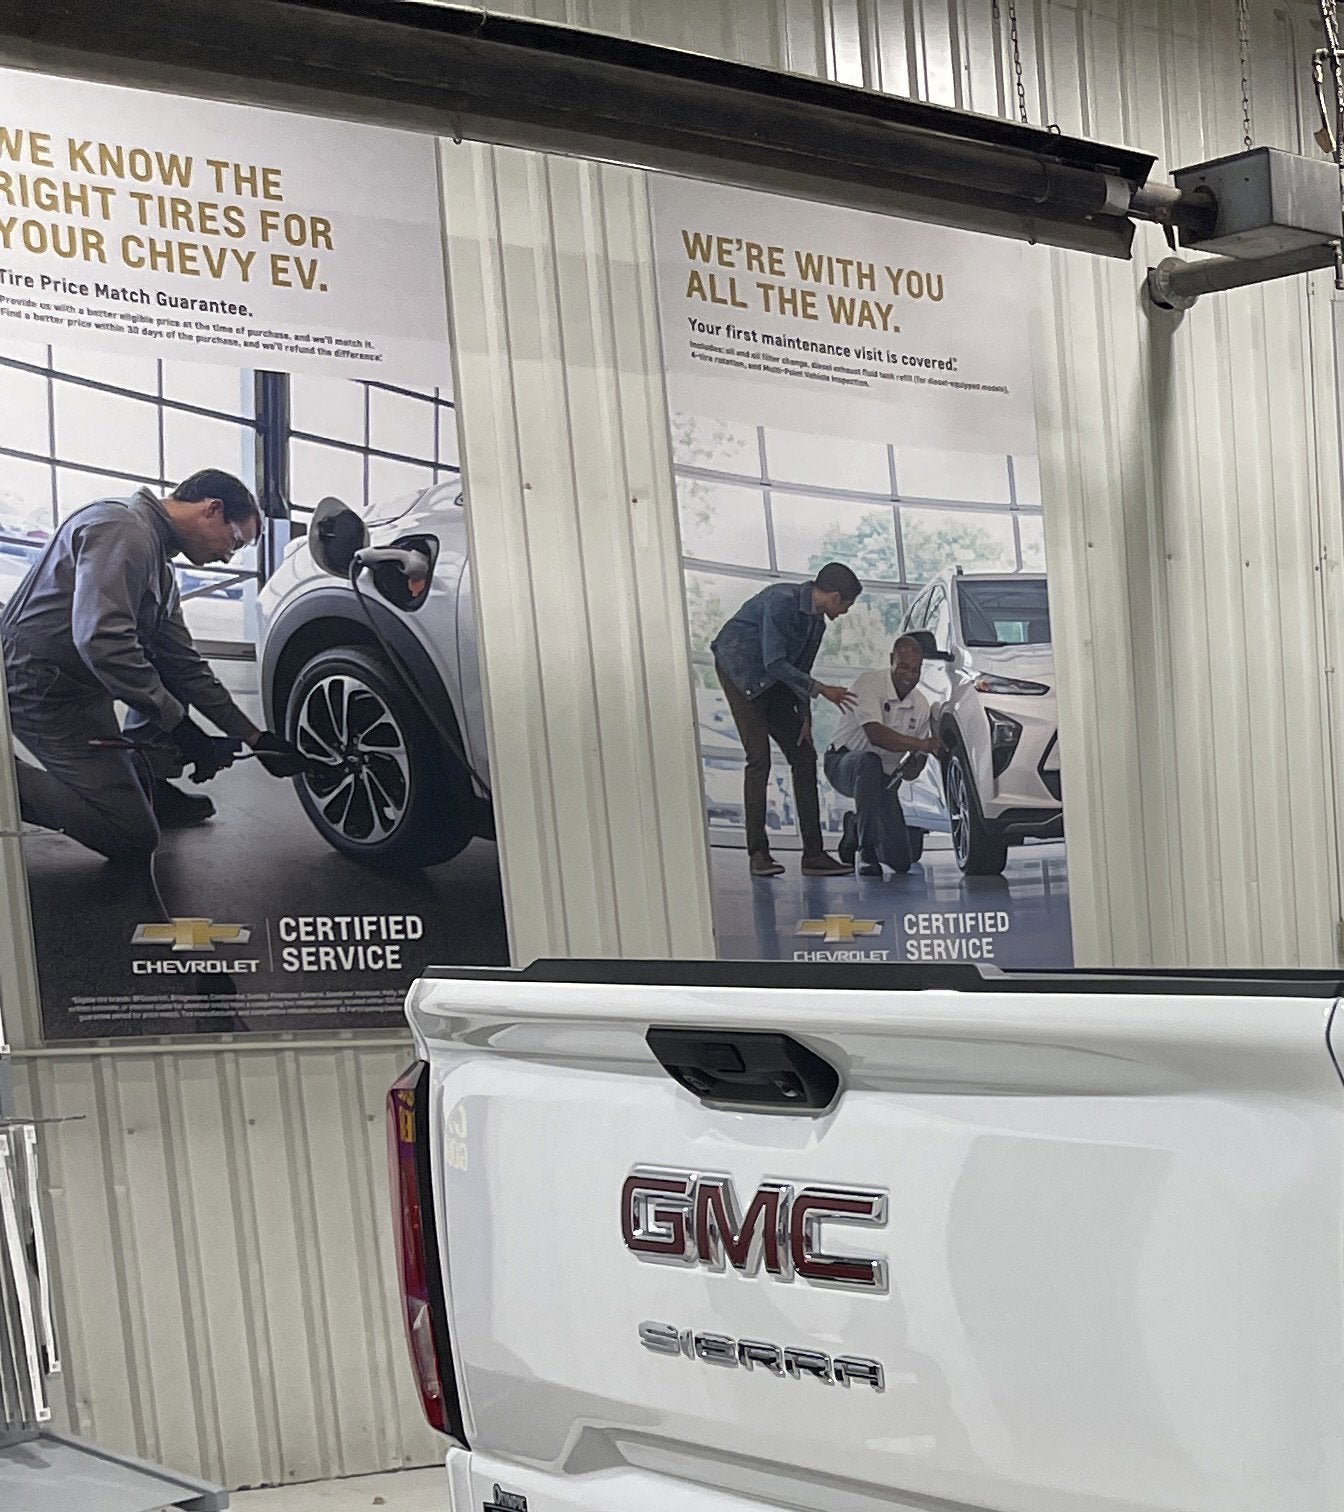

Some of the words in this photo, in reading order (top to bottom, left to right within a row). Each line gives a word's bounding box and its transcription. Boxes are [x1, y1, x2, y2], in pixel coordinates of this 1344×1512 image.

[0, 126, 54, 168] WE
[68, 138, 193, 188] KNOW
[206, 158, 284, 201] THE
[0, 170, 117, 221] RIGHT
[129, 190, 247, 240] TIRES
[260, 209, 334, 251] FOR
[0, 216, 107, 264] YOUR
[121, 234, 256, 283] CHEVY
[270, 253, 328, 292] EV.
[681, 229, 786, 278] WE'RE
[795, 249, 877, 292] WITH
[884, 265, 944, 302] YOU
[0, 269, 34, 288] Tire
[40, 275, 89, 296] Price
[95, 283, 151, 305] Match
[156, 291, 253, 317] Guarantee.
[686, 269, 748, 309] ALL
[756, 282, 819, 321] THE
[827, 294, 901, 334] WAY.
[688, 317, 721, 336] Your
[726, 324, 758, 343] first
[762, 333, 850, 357] maintenance
[854, 346, 884, 362] visit
[886, 350, 898, 364] is
[279, 915, 423, 942] CERTIFIED
[903, 911, 1010, 935] CERTIFIED
[132, 959, 260, 975] CHEVROLET
[282, 945, 402, 972] SERVICE
[793, 950, 890, 962] CHEVROLET
[906, 937, 995, 961] SERVICE
[621, 1162, 890, 1295] GMC
[638, 1319, 886, 1393] SIERRA
